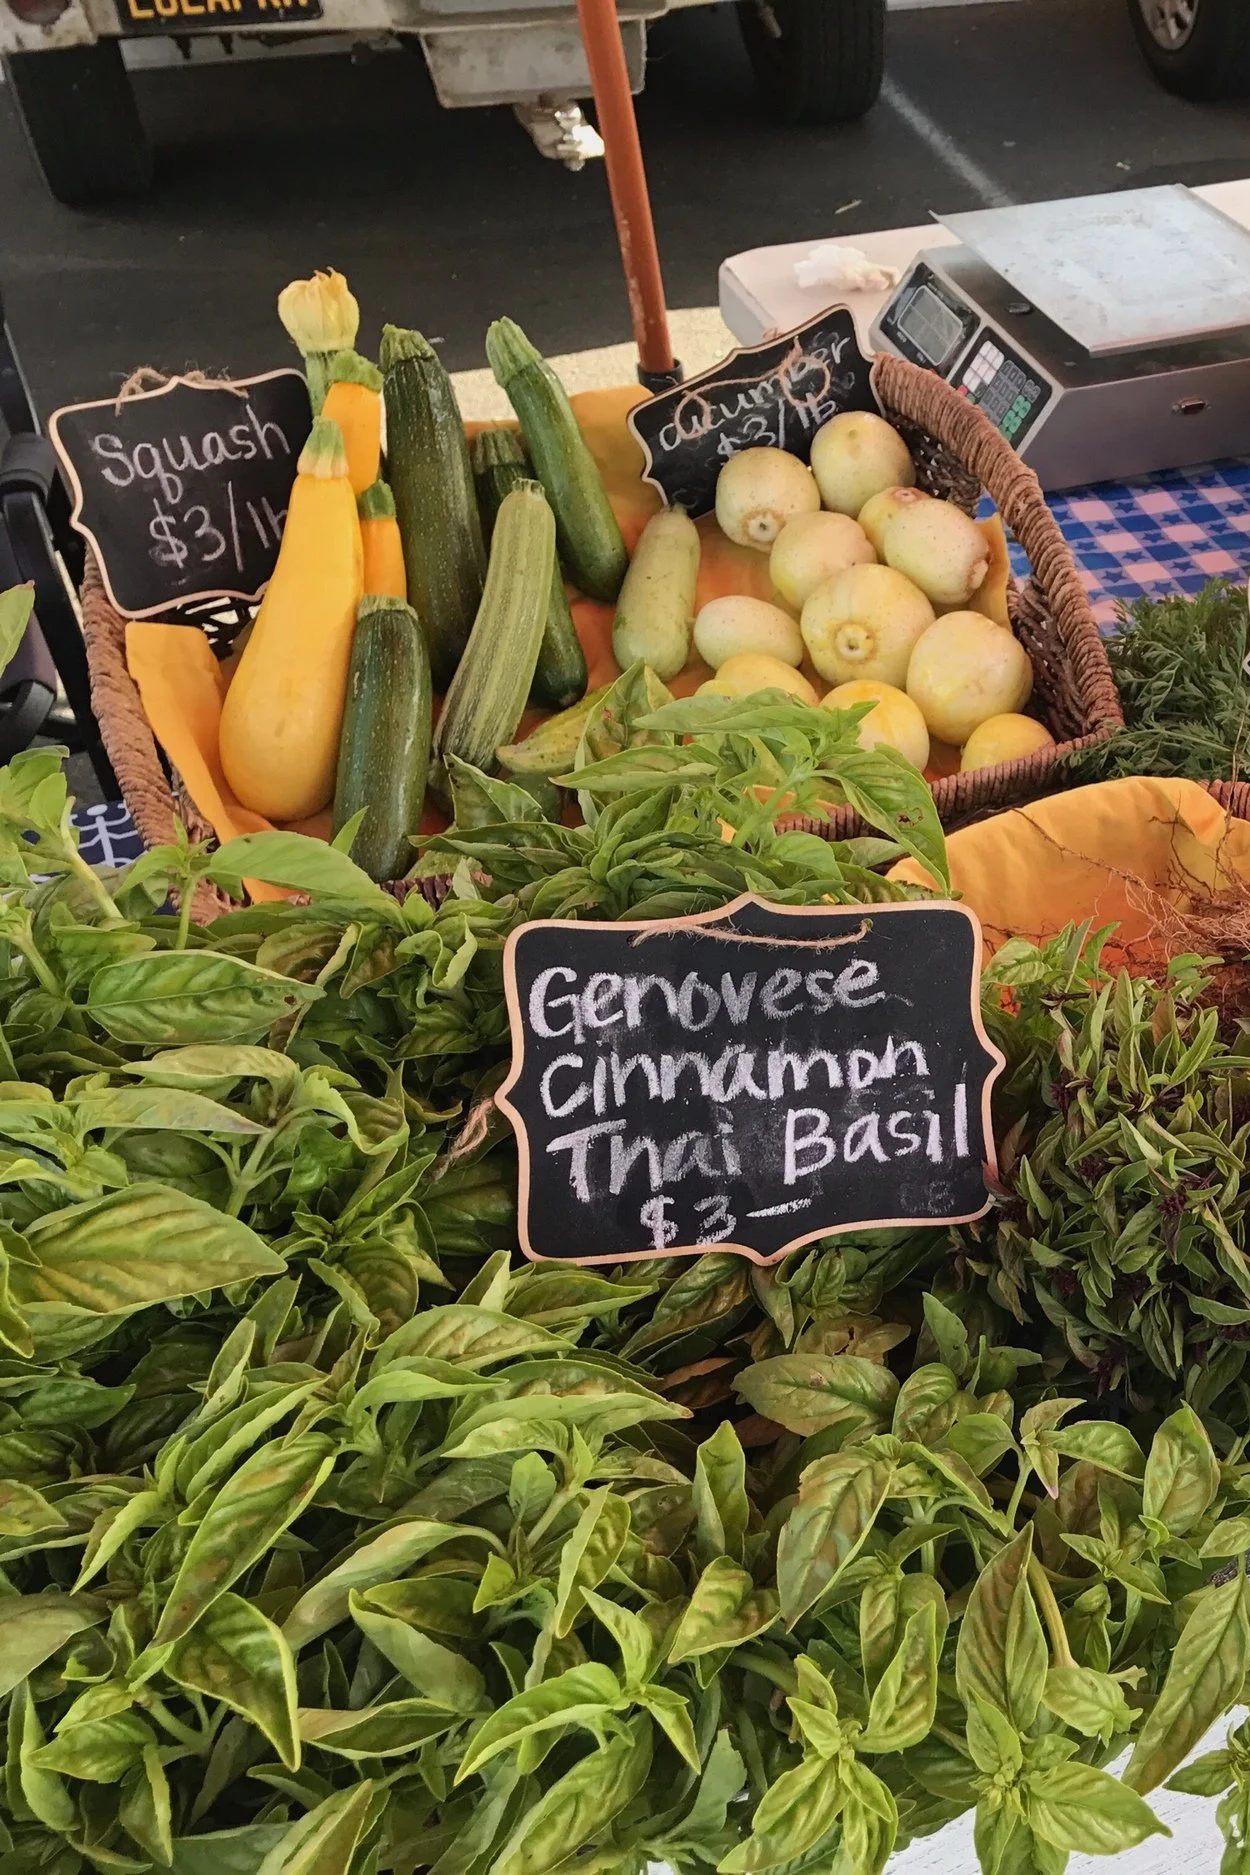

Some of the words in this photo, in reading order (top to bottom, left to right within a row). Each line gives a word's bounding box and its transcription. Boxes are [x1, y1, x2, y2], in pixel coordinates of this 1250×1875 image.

[91, 404, 291, 505] Squash
[528, 957, 890, 1044] Genovese
[541, 1035, 929, 1119] Cinnamon
[546, 1106, 742, 1203] Thai
[783, 1064, 970, 1185] Basil
